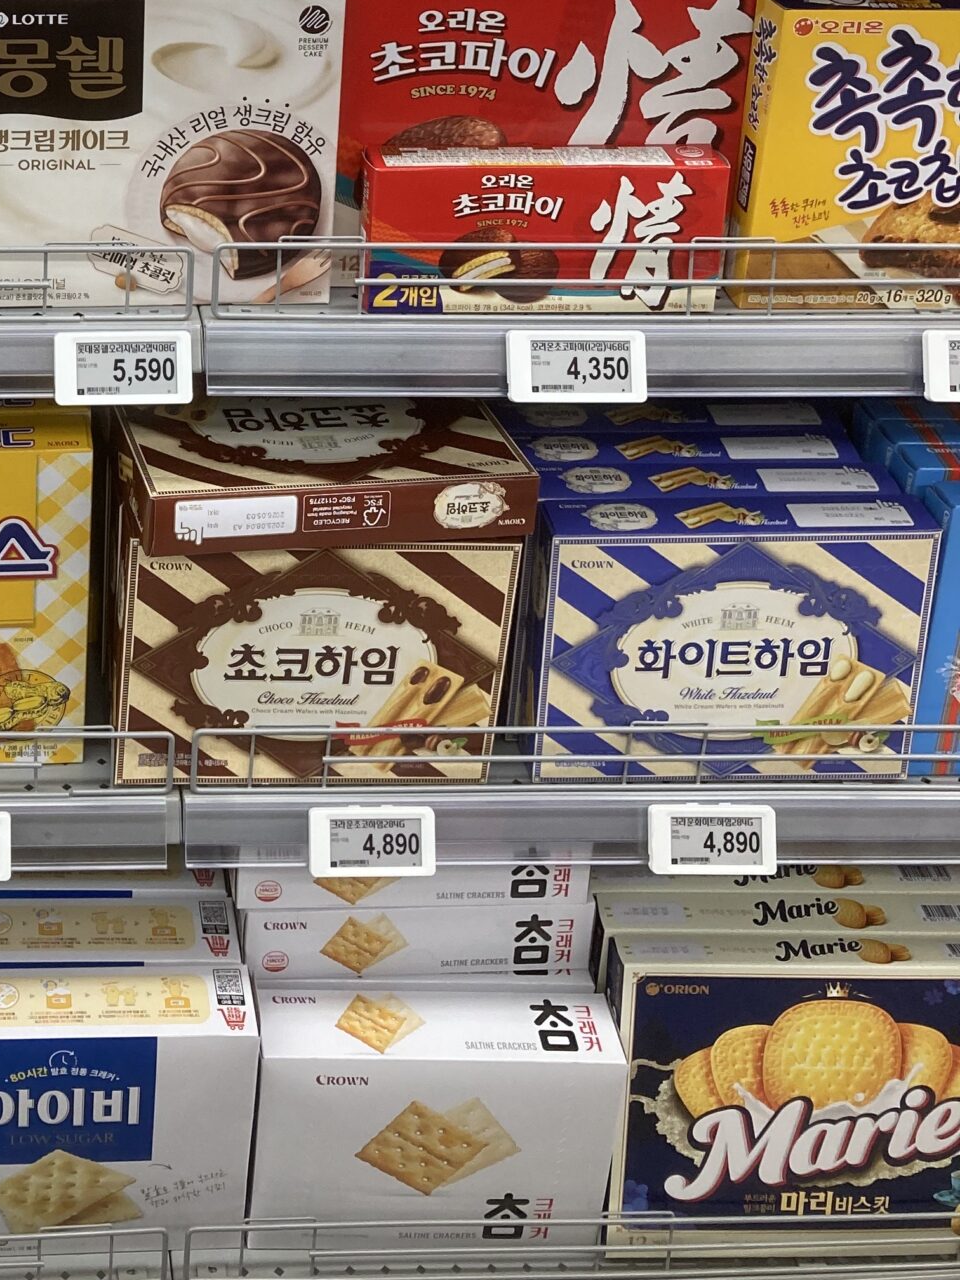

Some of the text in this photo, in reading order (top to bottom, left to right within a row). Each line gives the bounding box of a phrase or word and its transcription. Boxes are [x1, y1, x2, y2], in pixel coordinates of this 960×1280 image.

[12, 14, 69, 26] LOTTE
[417, 8, 507, 34] 오리온
[820, 20, 883, 34] 오리온
[370, 38, 559, 88] 초코파이
[410, 84, 497, 101] SINCE 1974
[808, 29, 960, 153] 촉촉
[18, 158, 96, 171] ORIGINAL
[838, 140, 960, 210] 초코칩
[480, 174, 535, 190] 오리온
[451, 192, 563, 221] 초코파이
[589, 171, 694, 308] 情
[113, 357, 176, 386] 5,590
[567, 356, 629, 384] 4,350
[149, 561, 193, 572] CROWN
[571, 559, 614, 570] CROWN
[258, 621, 376, 635] CHOCO HEIM
[681, 615, 796, 630] WHITE HEIM
[223, 644, 400, 687] 쵸코하임
[634, 635, 835, 679] 화이트하임
[679, 686, 778, 702] White Hazelnut
[363, 833, 420, 858] 4,890
[704, 830, 760, 856] 4,890
[753, 898, 839, 926] Marie
[774, 937, 862, 962] Marie
[271, 995, 316, 1005] CROWN
[664, 984, 710, 995] ORION
[529, 999, 603, 1053] 참 크래커
[465, 1041, 537, 1051] SALTINE CRACKERS
[10, 1066, 48, 1083] 80시간
[51, 1067, 68, 1076] 발효
[90, 1069, 117, 1082] 크래커
[315, 1075, 369, 1086] CROWN
[664, 1085, 960, 1201] Marie
